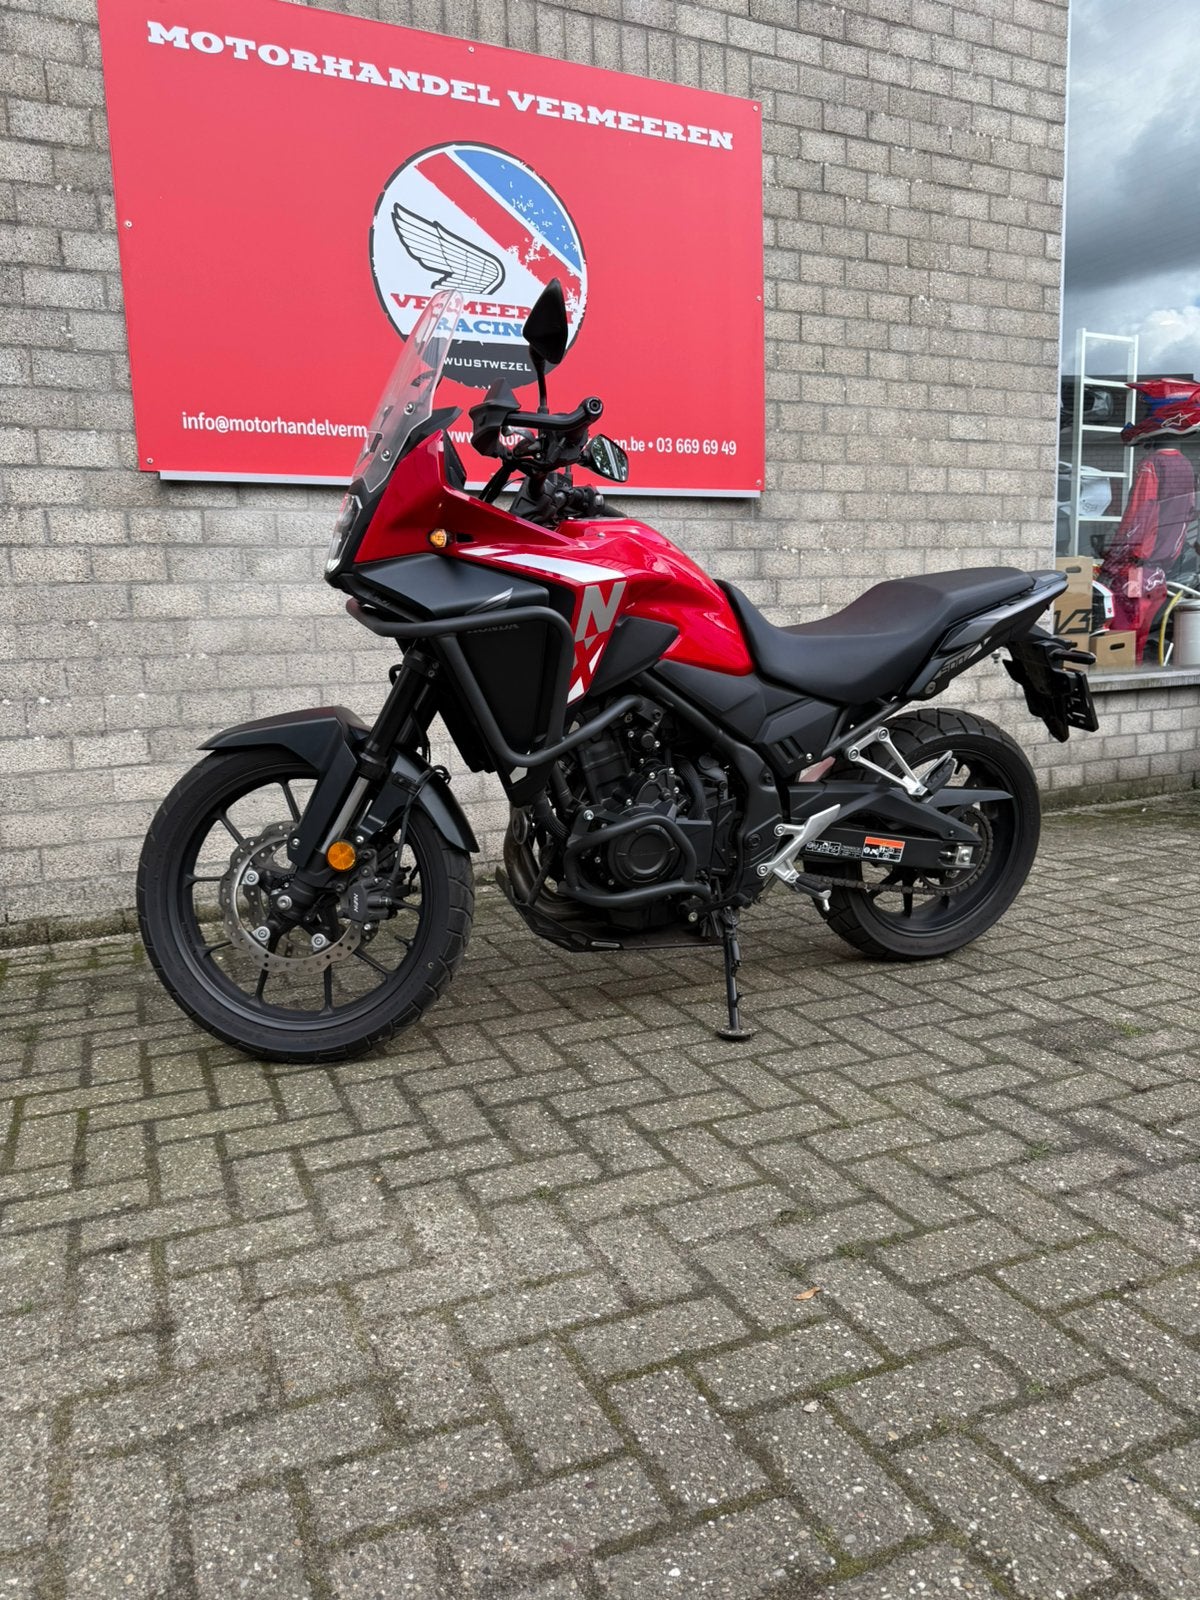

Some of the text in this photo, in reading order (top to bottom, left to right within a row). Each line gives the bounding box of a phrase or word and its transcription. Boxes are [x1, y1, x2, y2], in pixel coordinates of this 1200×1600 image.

[147, 20, 734, 150] MOTORHANDEL VERMEEREN
[435, 316, 523, 338] RACIN
[443, 356, 532, 372] WUUSTWEZEL
[182, 411, 368, 438] info@motorhandelverm
[656, 437, 673, 453] 03
[675, 438, 700, 454] 669
[702, 439, 719, 455] 69
[721, 440, 737, 456] 49
